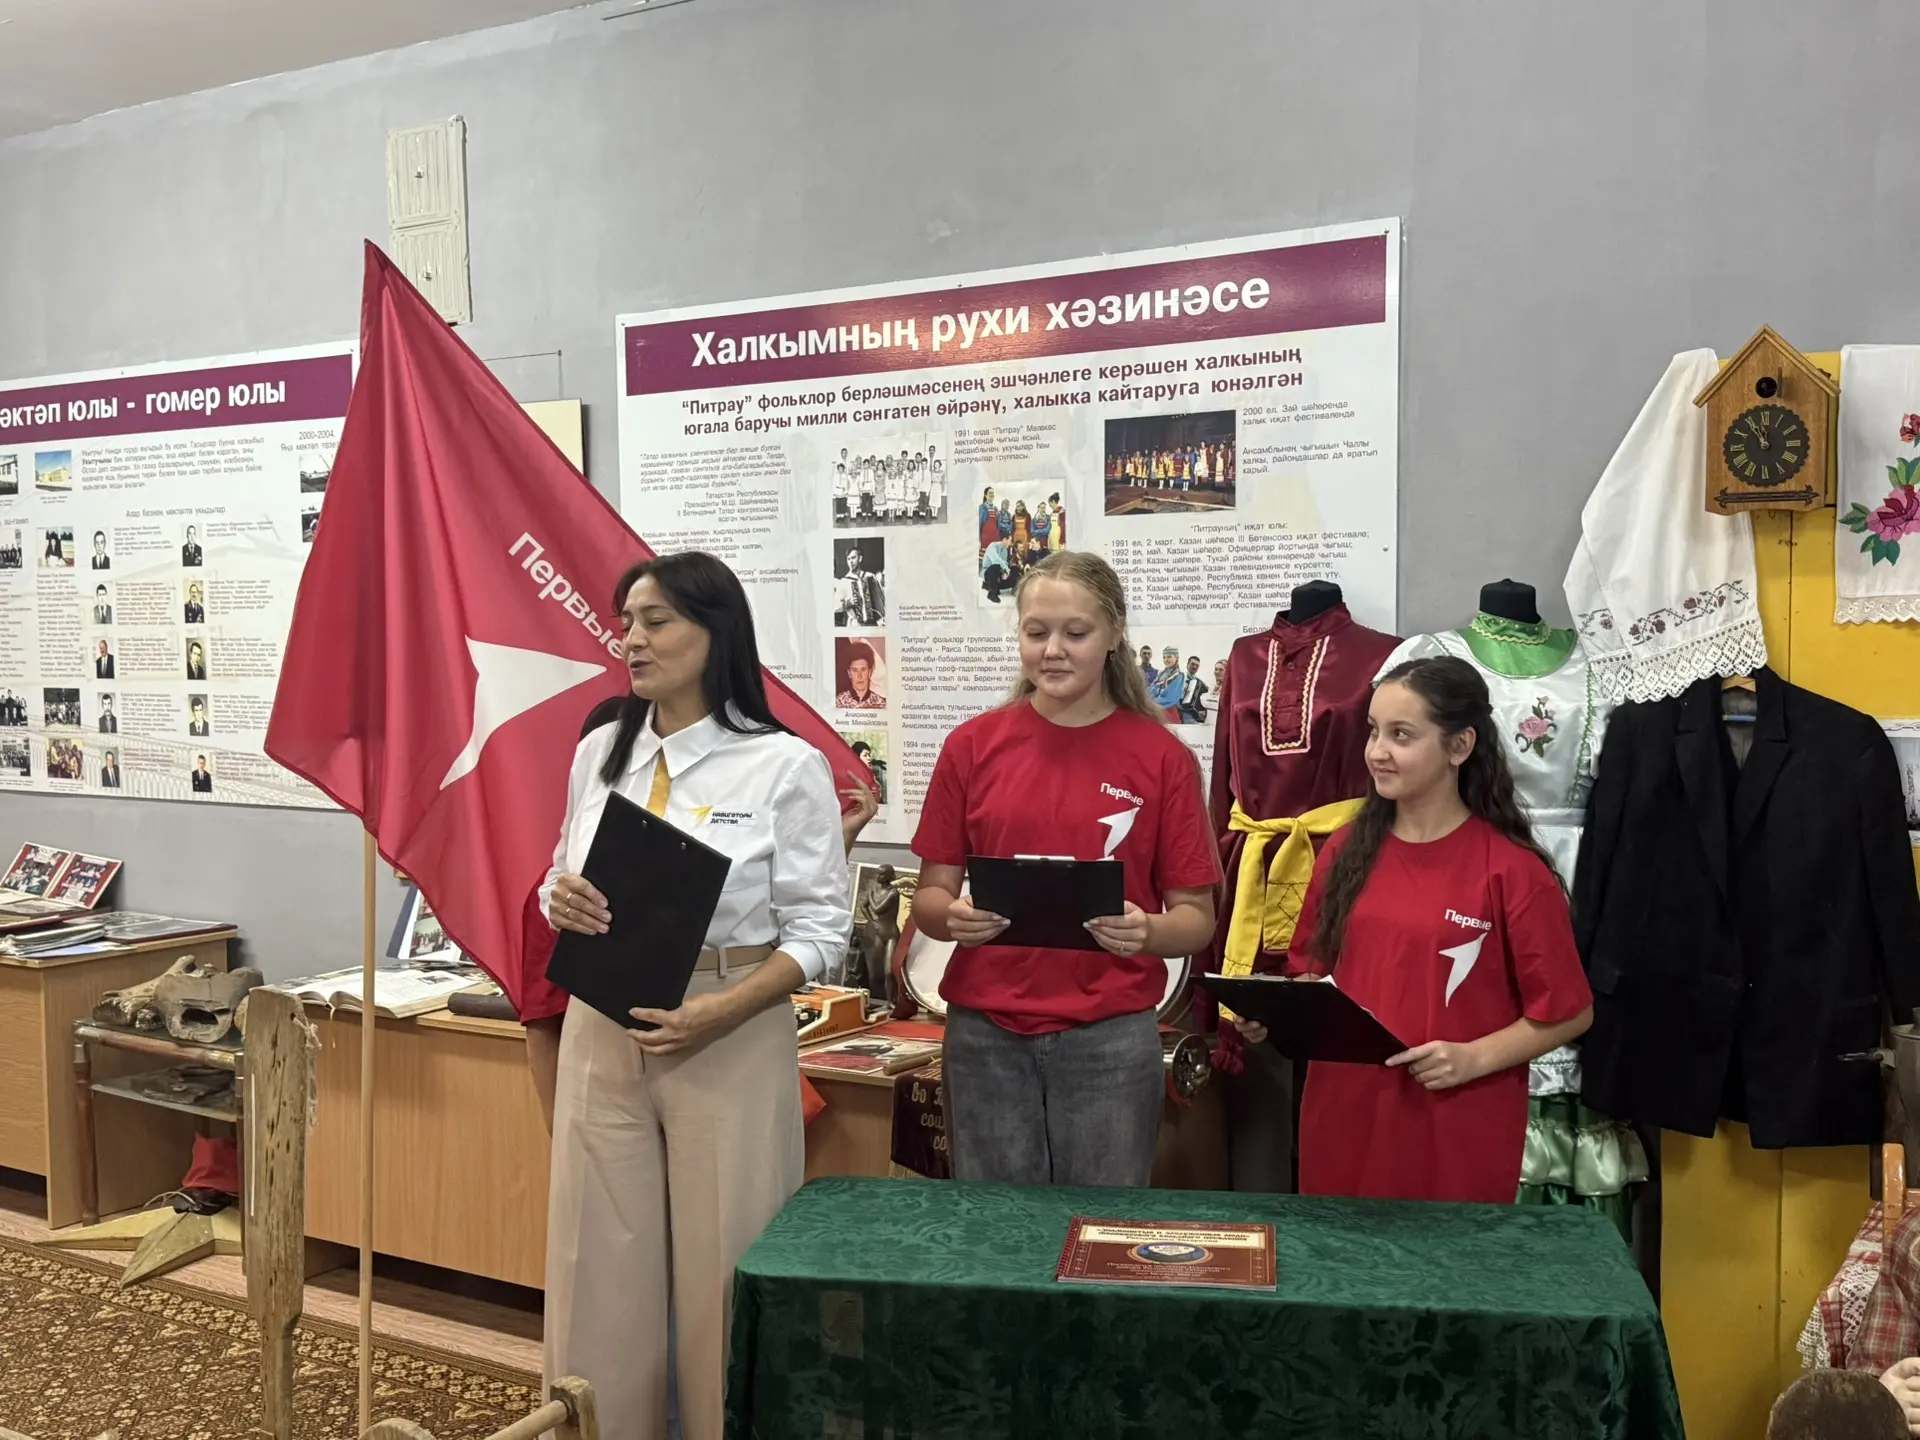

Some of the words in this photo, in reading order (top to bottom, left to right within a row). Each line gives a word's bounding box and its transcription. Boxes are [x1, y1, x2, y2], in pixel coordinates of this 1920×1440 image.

[692, 326, 919, 367] Халкымның
[933, 306, 1029, 352] рухи
[1047, 278, 1269, 330] хәзинәсе
[0, 404, 60, 428] әктәп
[68, 397, 117, 422] юлы
[146, 386, 220, 415] гомер
[228, 381, 285, 406] юлы
[685, 418, 729, 435] югала
[735, 412, 791, 432] баручы
[797, 411, 847, 427] милли
[853, 405, 930, 423] сәнгатен
[937, 396, 1007, 418] өйрәнү,
[1014, 389, 1090, 410] халыкка
[1099, 380, 1199, 404] кайтаруга
[1211, 371, 1302, 393] юнәлгән
[758, 390, 835, 411] фольклор
[841, 377, 985, 402] берләшмәсенең
[991, 368, 1091, 389] эшчәнлеге
[1099, 360, 1187, 382] керәшен
[1195, 347, 1302, 370] халкының
[508, 532, 623, 659] Первые
[1100, 782, 1143, 805] Первые
[1445, 909, 1492, 930] Первые
